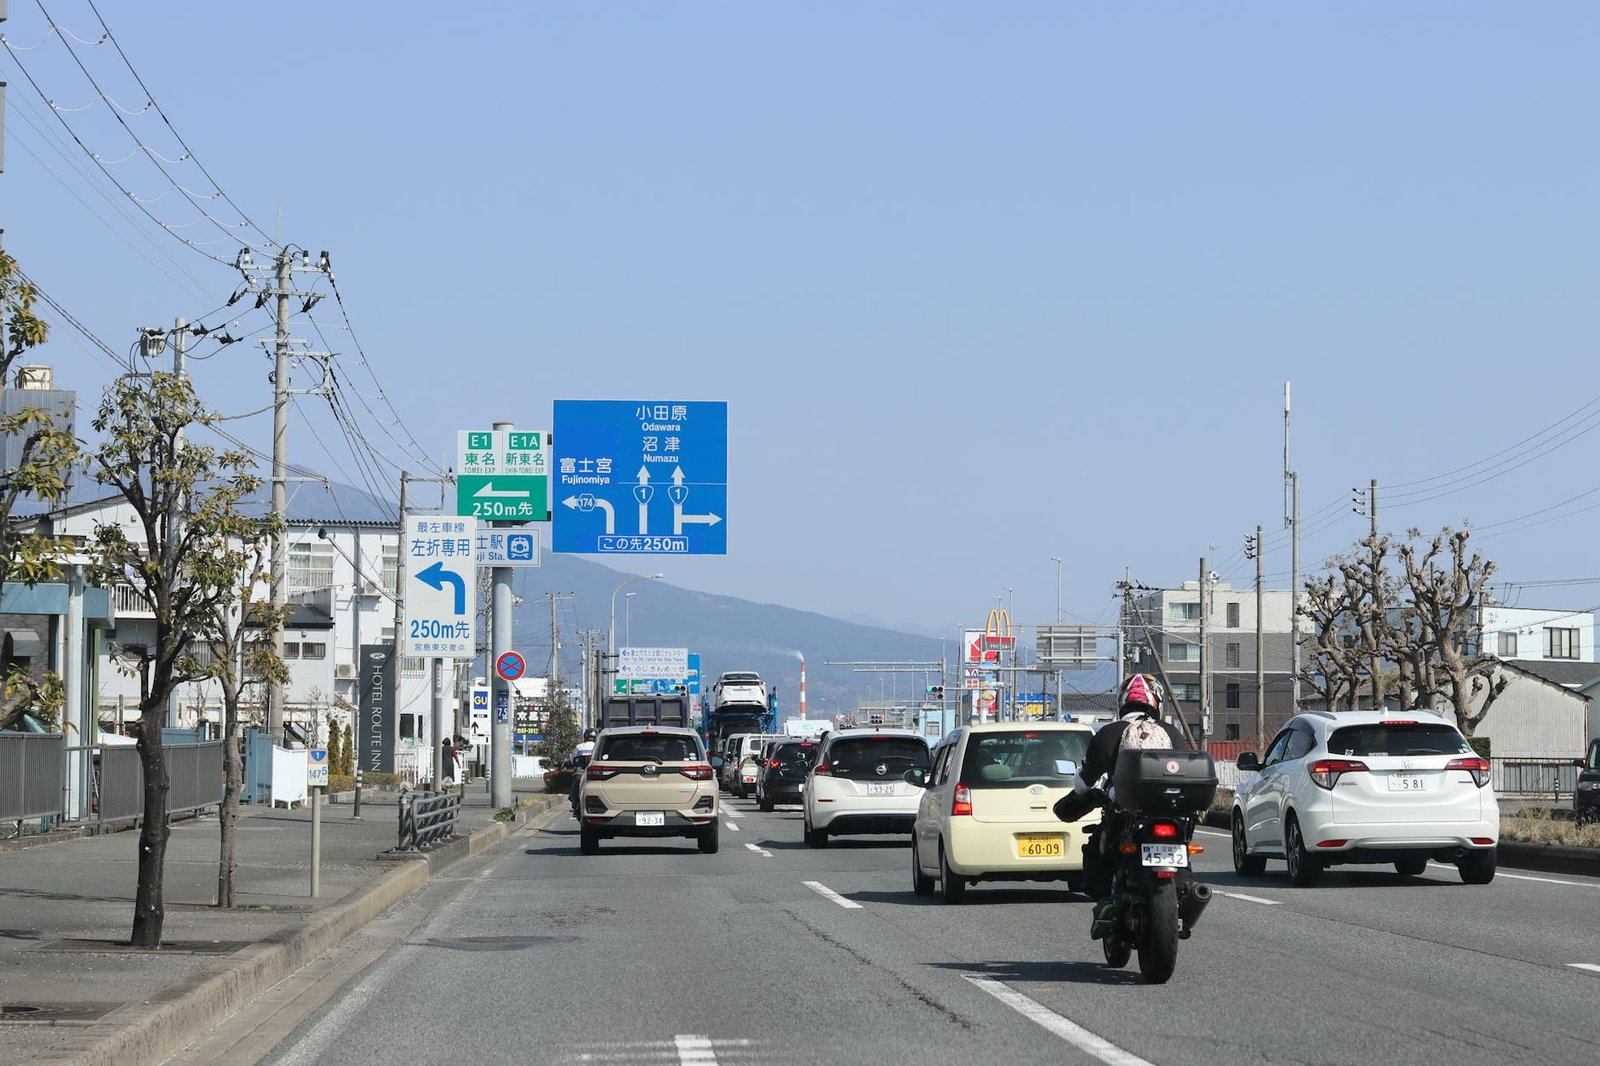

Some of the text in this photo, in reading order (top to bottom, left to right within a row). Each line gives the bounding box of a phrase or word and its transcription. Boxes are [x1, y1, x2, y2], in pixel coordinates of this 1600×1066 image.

[636, 405, 687, 421] 小田原
[642, 423, 681, 432] Odawara
[472, 435, 487, 447] E1
[511, 435, 538, 447] E1A
[642, 436, 680, 452] 沼津
[465, 452, 495, 465] 東名
[505, 452, 544, 465] 新東名
[643, 454, 679, 463] Numazu
[560, 458, 612, 474] 富士宮
[562, 475, 610, 485] Fujinomiya
[641, 489, 646, 499] 1
[675, 489, 681, 499] 1
[472, 501, 533, 517] 250m先
[580, 498, 592, 508] 174
[417, 522, 465, 533] 最左車線
[411, 538, 470, 557] 左折専用
[477, 534, 503, 550] 士駅
[603, 539, 685, 552] この先250m
[488, 552, 505, 560] Sta.
[410, 620, 470, 639] 250m先
[414, 643, 465, 652] 宮島東交差点
[474, 696, 488, 705] GU
[371, 665, 384, 771] HOTEL ROUTE INN
[1028, 843, 1060, 855] 60-09
[1145, 852, 1184, 865] 45-32
